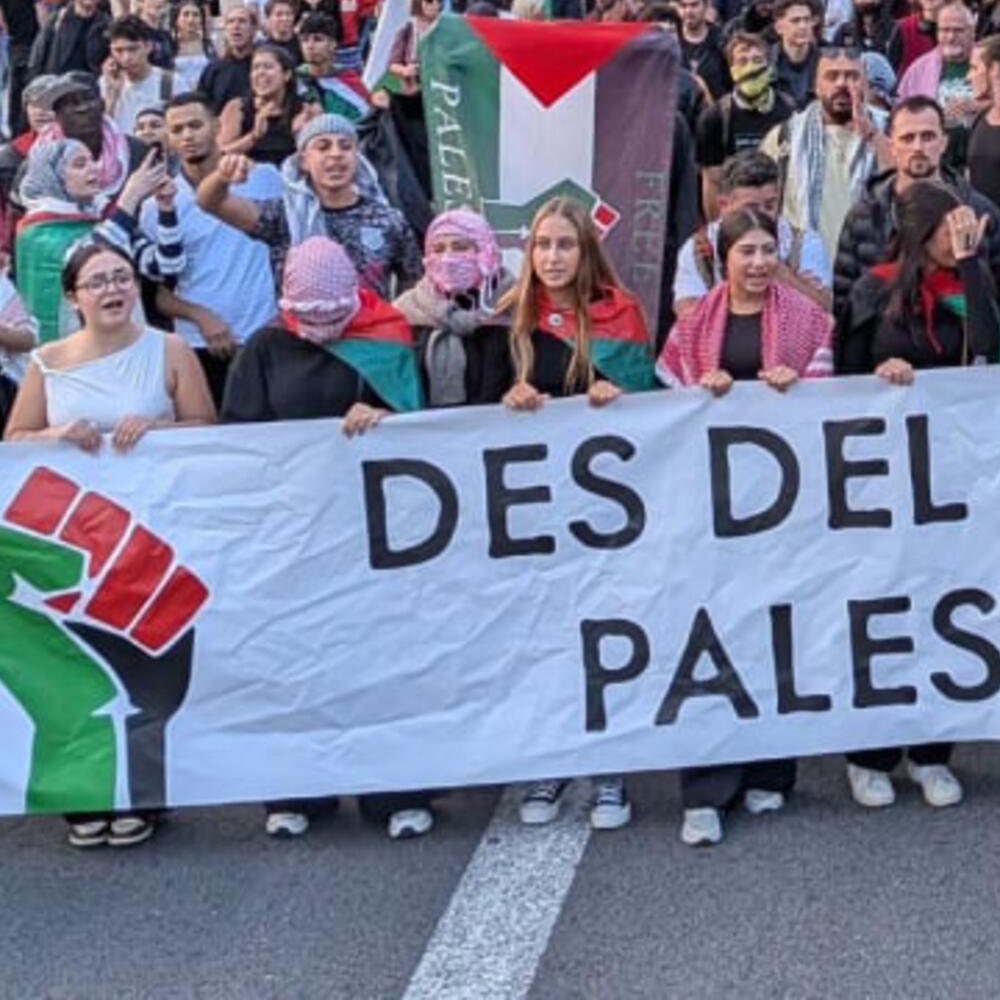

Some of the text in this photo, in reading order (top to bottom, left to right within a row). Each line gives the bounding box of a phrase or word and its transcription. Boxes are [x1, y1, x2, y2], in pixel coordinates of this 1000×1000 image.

[430, 79, 475, 212] PALE
[361, 435, 647, 570] DES
[707, 414, 969, 539] DEL
